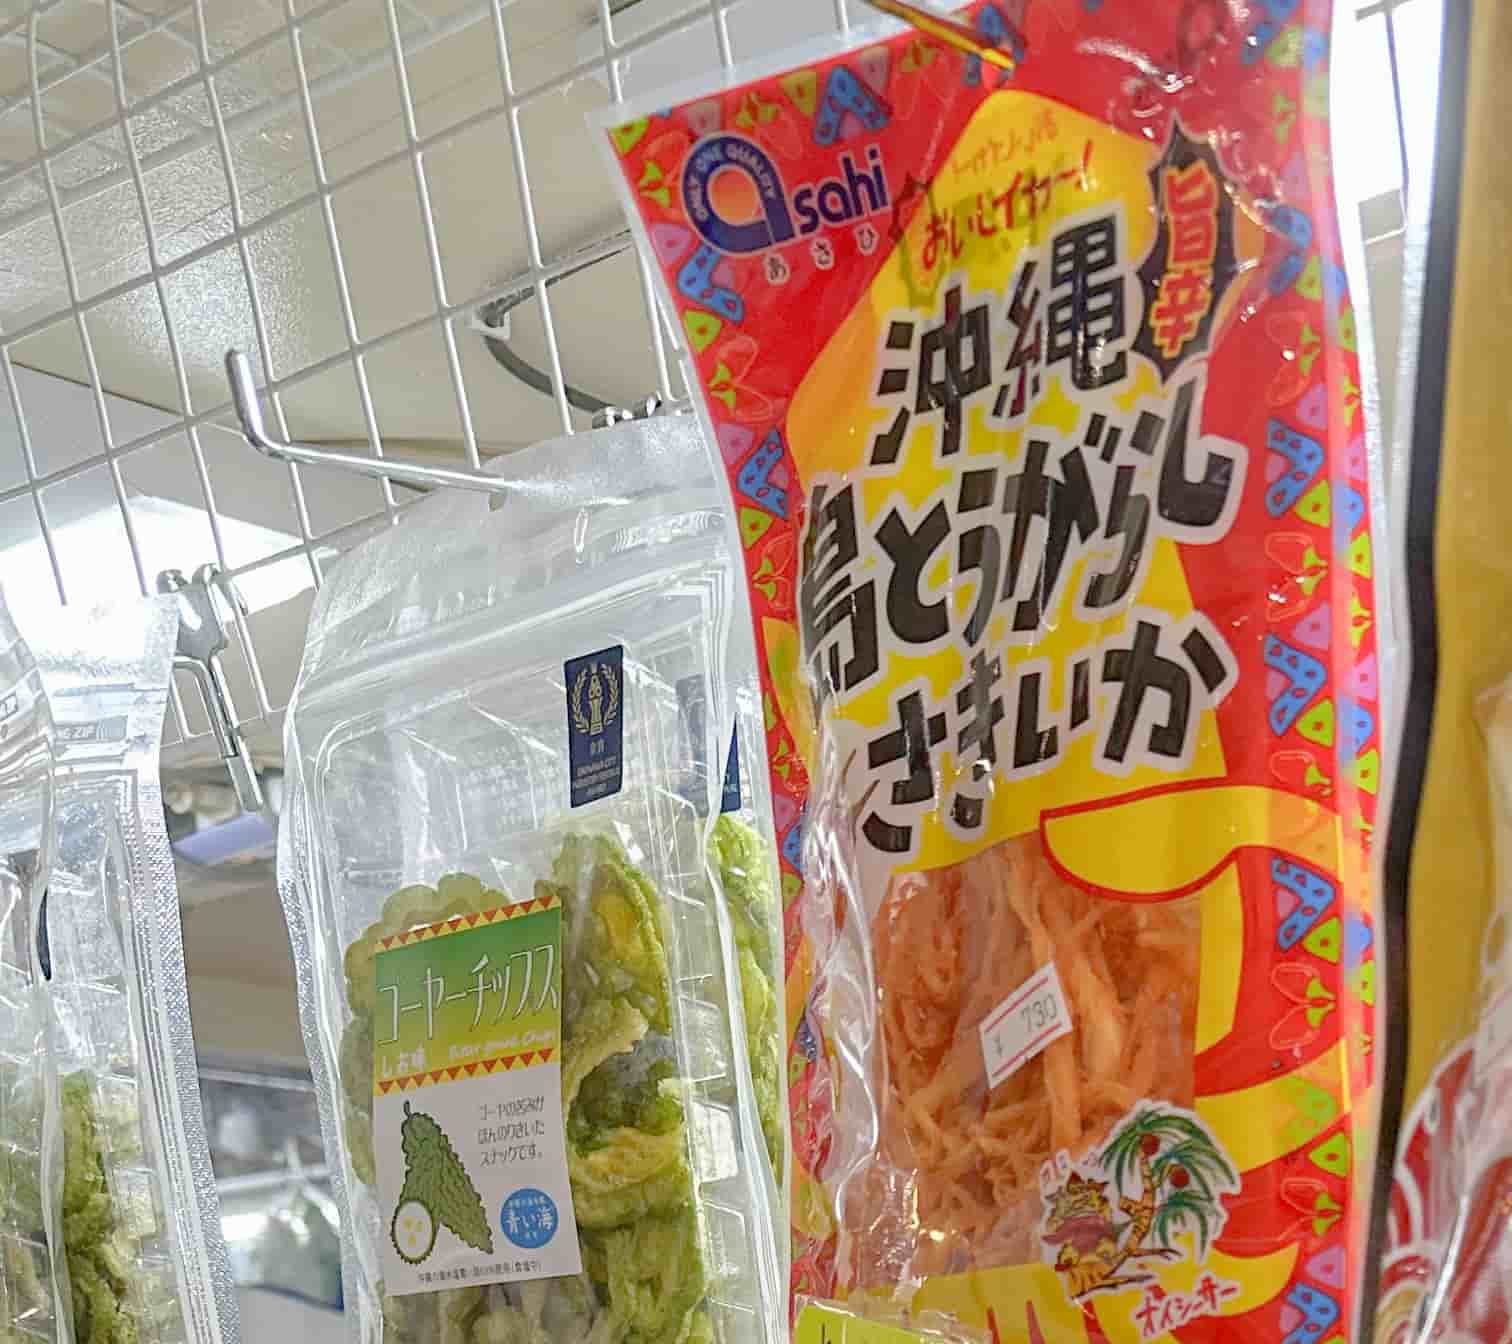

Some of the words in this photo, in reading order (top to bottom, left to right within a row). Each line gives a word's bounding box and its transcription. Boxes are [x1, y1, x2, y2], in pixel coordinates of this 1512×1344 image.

[764, 222, 880, 285] あさひ
[869, 214, 1128, 468] 沖縄
[1152, 160, 1219, 360] 旨辛
[859, 619, 1230, 855] さきいか
[1020, 993, 1058, 1033] 730
